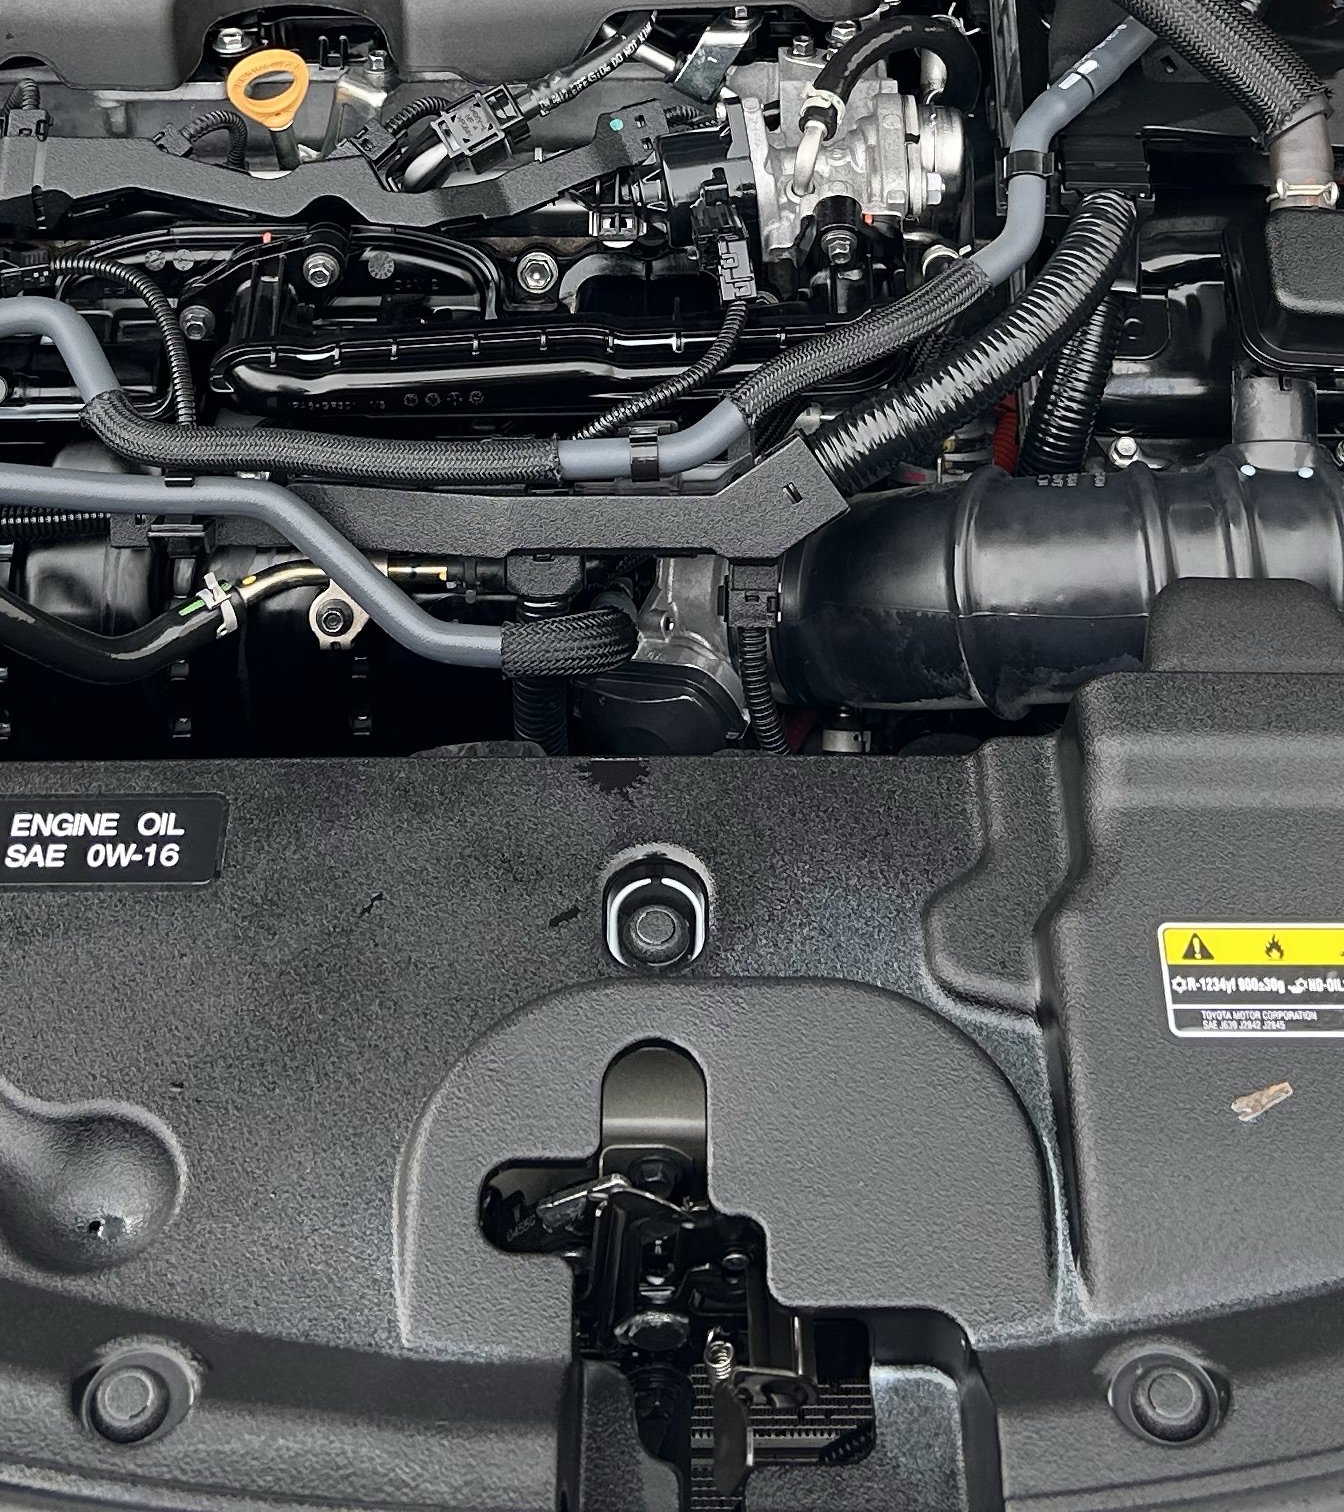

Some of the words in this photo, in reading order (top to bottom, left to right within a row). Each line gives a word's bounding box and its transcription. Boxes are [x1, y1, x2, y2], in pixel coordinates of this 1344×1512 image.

[611, 52, 624, 68] DO
[623, 39, 638, 58] NOT
[10, 812, 120, 837] ENGINE
[137, 812, 185, 836] OIL
[5, 844, 67, 868] SAE
[86, 843, 180, 868] 0W-16
[1201, 1010, 1233, 1020] TOYOTA
[1232, 1010, 1261, 1020] MOTOR
[1261, 1010, 1318, 1021] CORPORATION
[1202, 1020, 1218, 1030] SAE
